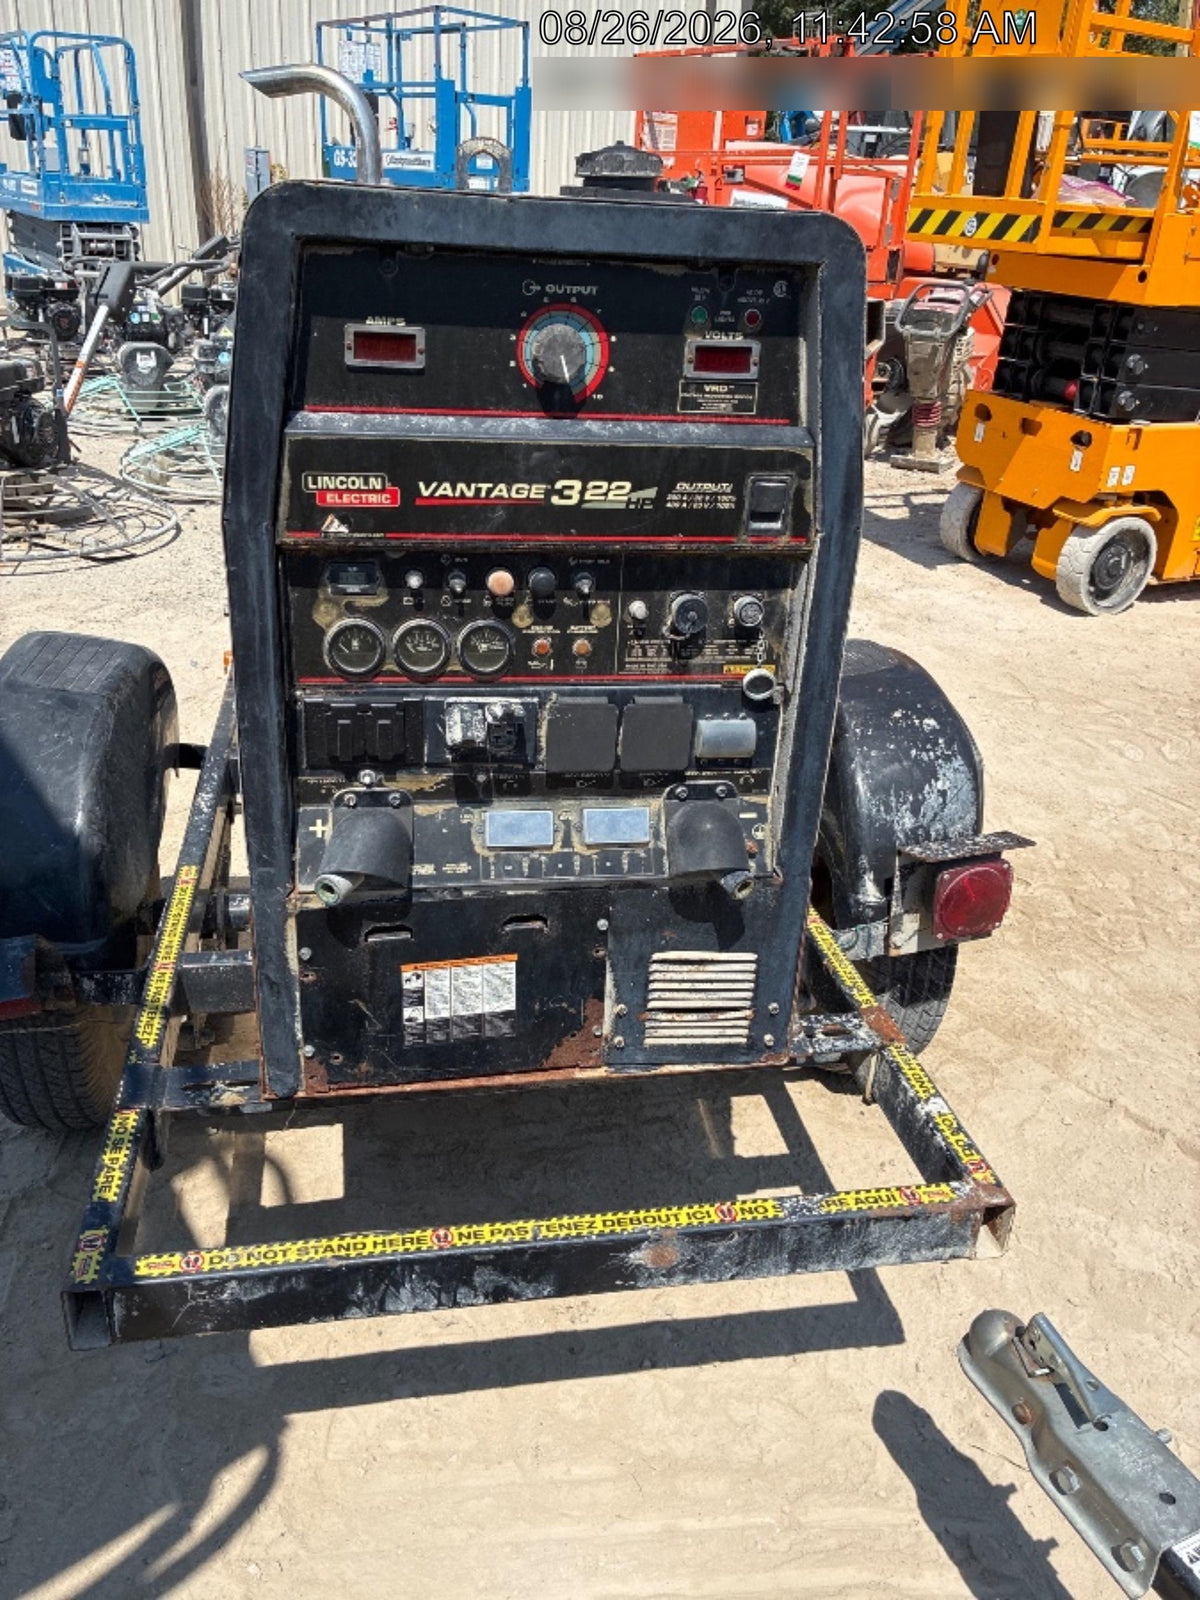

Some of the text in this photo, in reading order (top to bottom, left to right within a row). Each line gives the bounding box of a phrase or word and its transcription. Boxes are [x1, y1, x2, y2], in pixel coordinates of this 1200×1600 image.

[545, 283, 599, 295] OUTPUT
[705, 330, 744, 341] VOLTS
[307, 476, 382, 490] LINCOLN
[418, 481, 545, 499] VANTAGE
[326, 493, 391, 504] ELECTRIC
[740, 1205, 768, 1216] NO
[457, 1210, 712, 1241] NE PAS TENEZ DEBOUT ICI
[209, 1235, 428, 1265] DO NOT STAND HERE
